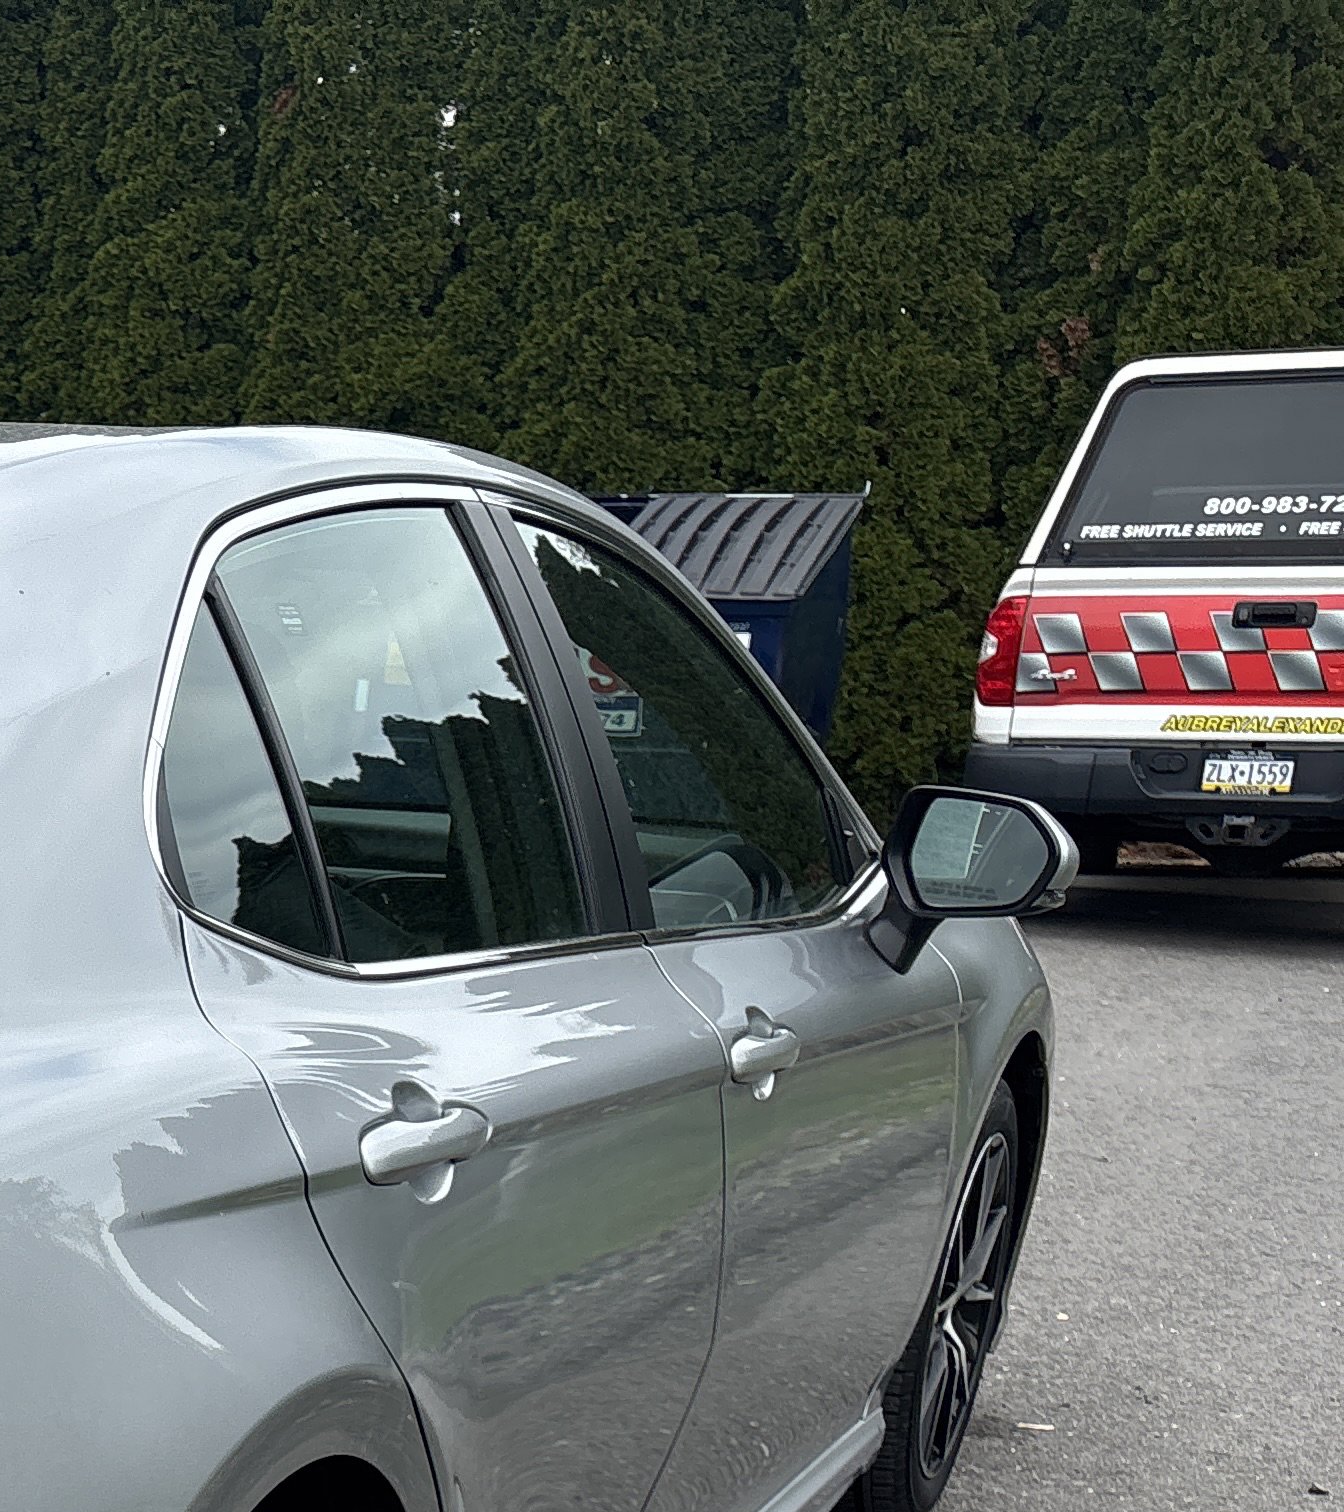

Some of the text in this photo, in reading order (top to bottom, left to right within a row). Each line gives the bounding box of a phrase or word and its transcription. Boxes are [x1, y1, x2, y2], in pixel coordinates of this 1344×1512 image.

[1204, 495, 1344, 514] 800-983-72
[1080, 521, 1342, 539] FREE SHUTTLE SERVICE FREE
[1160, 714, 1344, 734] AUBREYALEXAND
